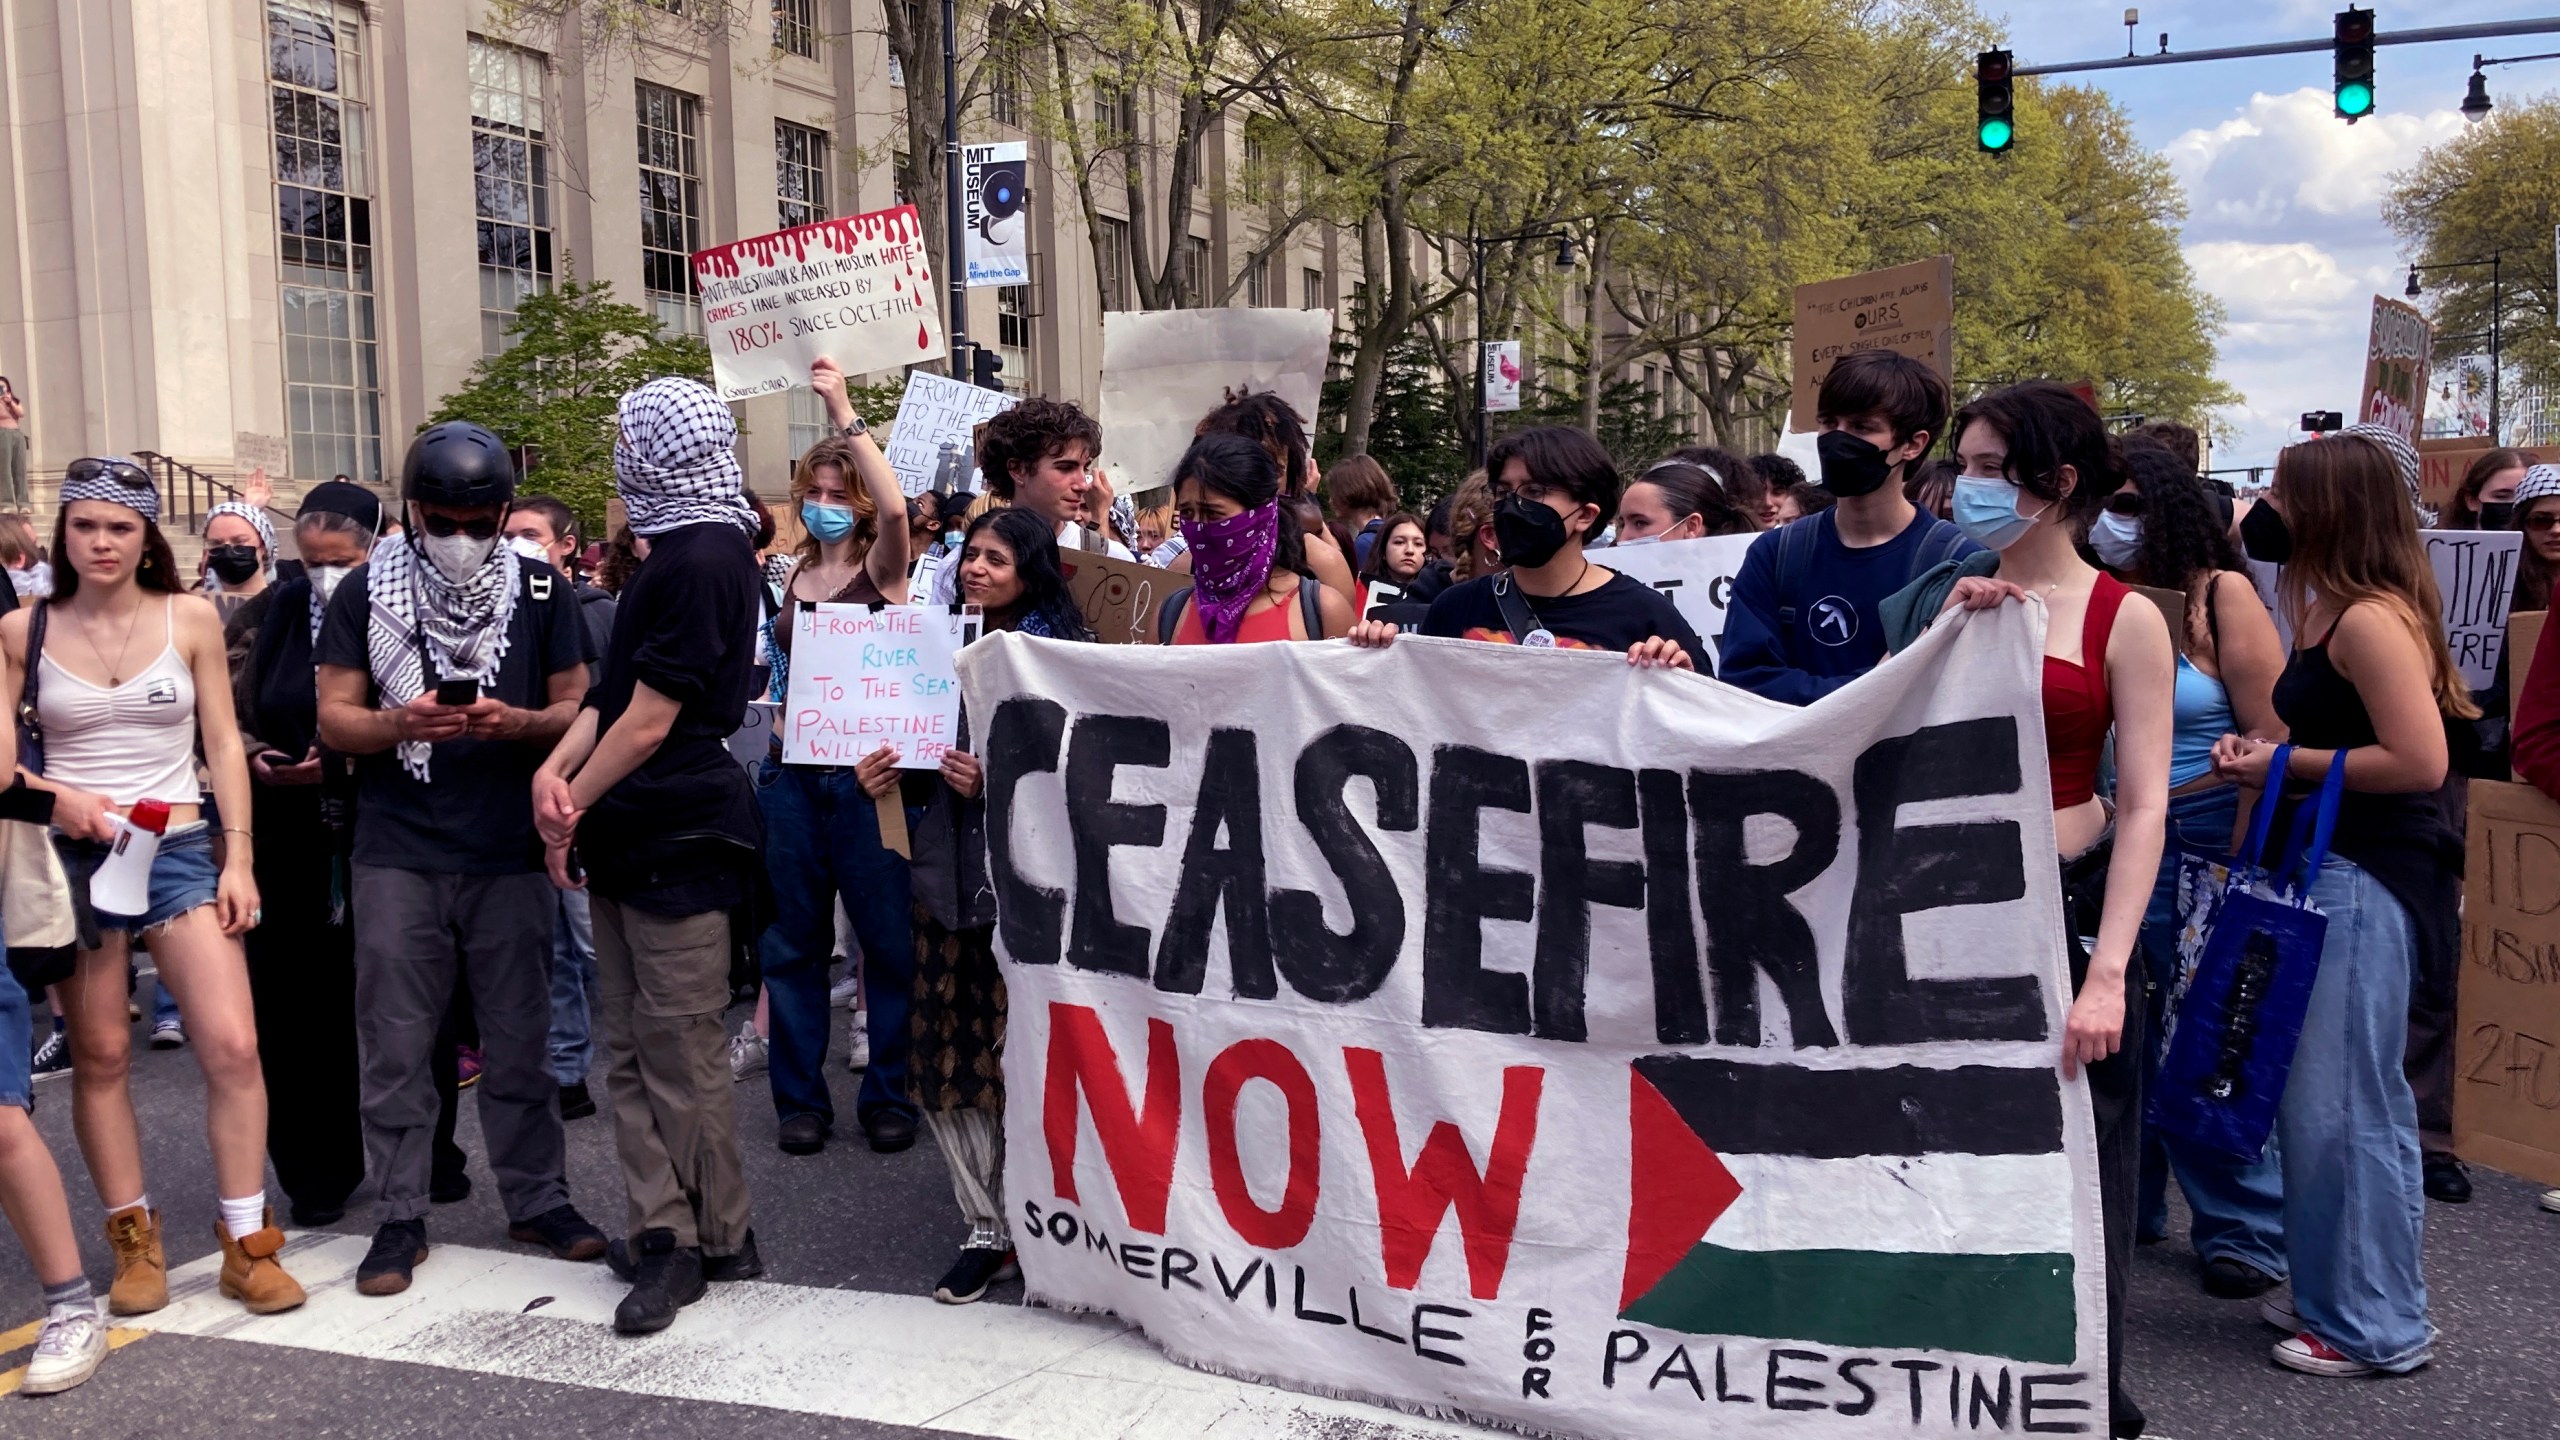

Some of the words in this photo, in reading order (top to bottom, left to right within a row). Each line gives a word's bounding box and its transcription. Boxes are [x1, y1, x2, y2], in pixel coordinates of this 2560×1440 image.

[967, 147, 995, 163] MIT
[702, 268, 788, 305] ANTI-PALESTINIAN
[880, 244, 914, 265] HATE
[969, 262, 979, 270] AI:
[969, 270, 988, 279] Mind
[990, 269, 1002, 278] the
[1004, 268, 1020, 278] Gap
[706, 302, 747, 323] CRIMES
[751, 295, 781, 312] HAVE
[785, 282, 851, 305] INCREASED
[857, 278, 872, 294] BY
[1840, 295, 1877, 311] CHILDREN
[1880, 291, 1895, 300] ARE
[728, 321, 783, 355] 180%
[789, 312, 837, 337] SINCE
[1812, 345, 1843, 363] EVERY
[1850, 338, 1878, 350] SINGLE
[1881, 335, 1899, 346] ONE
[1901, 331, 1913, 343] OF
[909, 376, 959, 405] FROM
[963, 386, 996, 412] THE
[903, 402, 929, 420] TO
[937, 407, 972, 430] THE
[889, 445, 929, 468] WILL
[885, 612, 922, 635] THE
[861, 643, 919, 669] RIVER
[861, 677, 901, 700] THE
[796, 709, 945, 743] PALESTINE
[810, 739, 869, 759] WILL
[983, 695, 2049, 1050] CEASEFIRE
[1041, 1001, 1545, 1301] NOW
[1023, 1200, 1471, 1368] SOMERVILLE
[1522, 1307, 1556, 1400] FOR
[1602, 1328, 2091, 1434] PALESTINE
